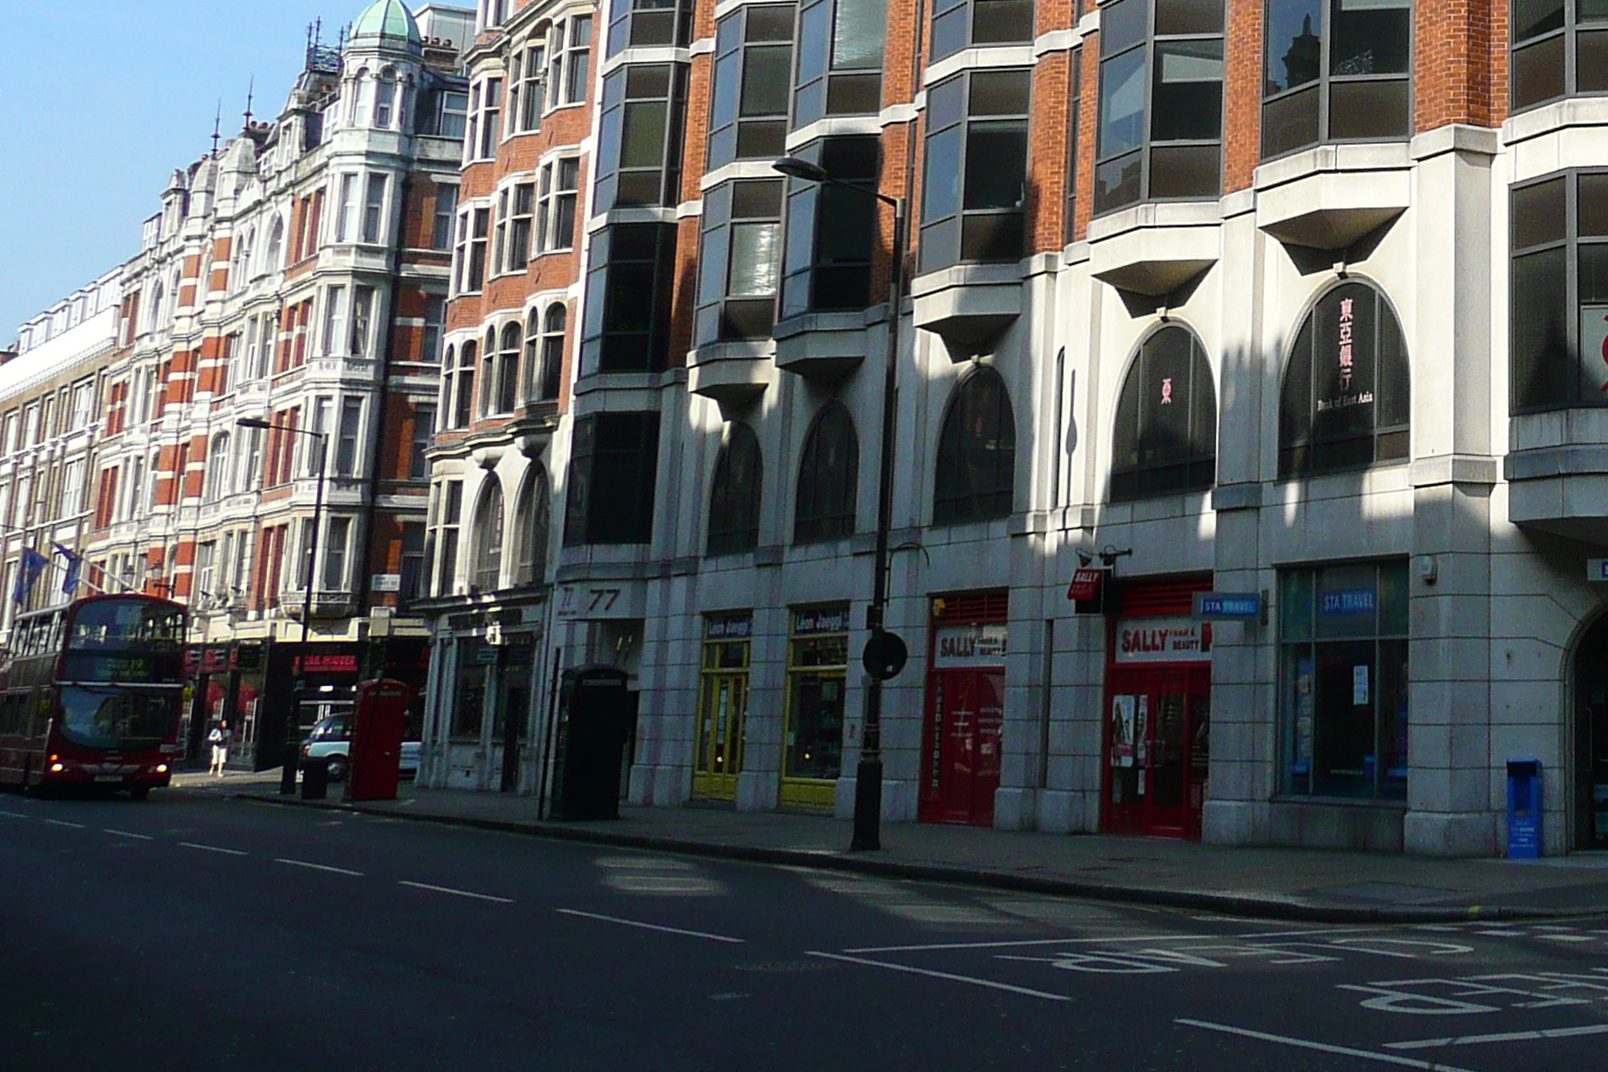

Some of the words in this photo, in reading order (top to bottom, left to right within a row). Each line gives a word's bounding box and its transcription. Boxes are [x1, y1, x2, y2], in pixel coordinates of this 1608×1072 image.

[1358, 391, 1373, 404] Asia
[1075, 571, 1100, 583] SALLY
[590, 589, 621, 611] 77
[1205, 601, 1221, 611] STA
[1222, 601, 1256, 612] TRAVEL
[1324, 595, 1340, 611] STA
[1342, 593, 1374, 609] TRAVEL
[941, 637, 976, 657] SALLY
[1122, 629, 1168, 652] SALLY
[1172, 640, 1199, 650] BEAUTY
